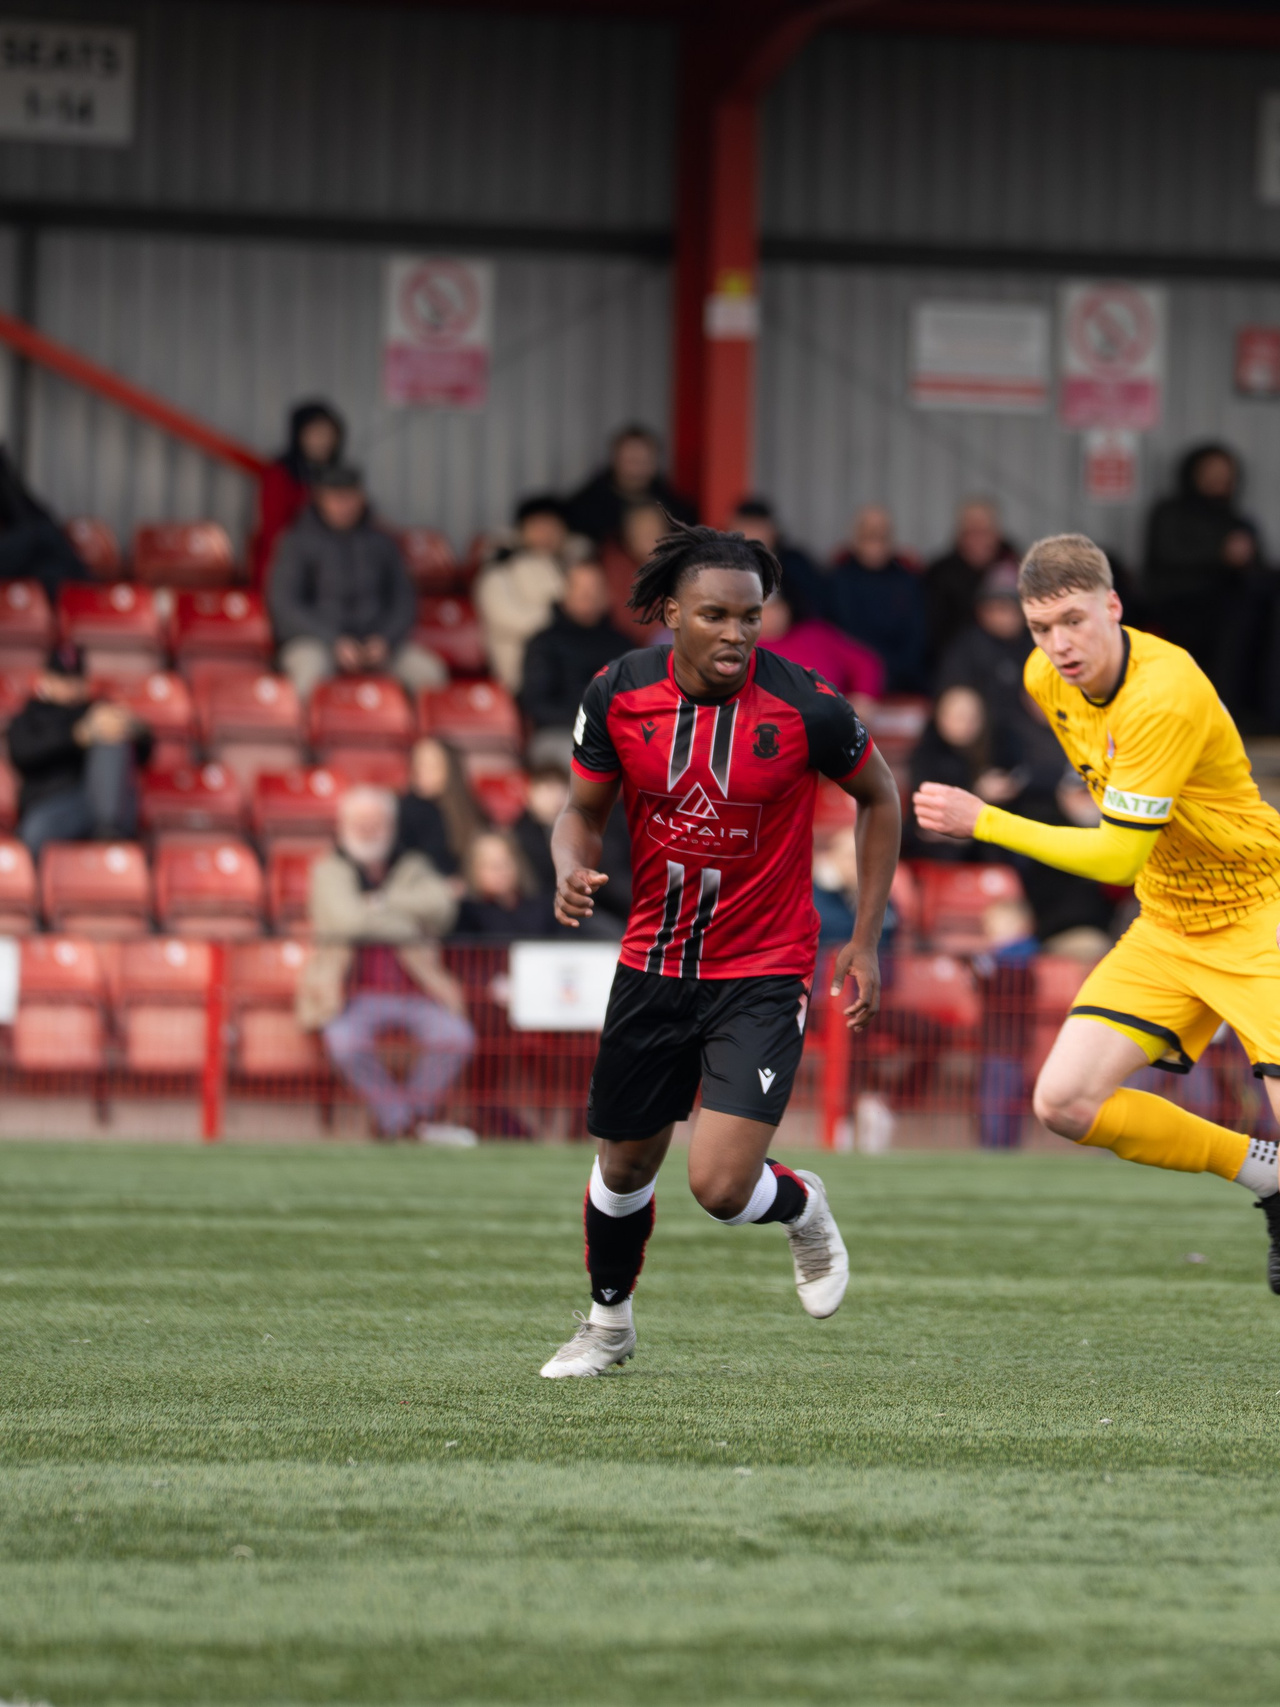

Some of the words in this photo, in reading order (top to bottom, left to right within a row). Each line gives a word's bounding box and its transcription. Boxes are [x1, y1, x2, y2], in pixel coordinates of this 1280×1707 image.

[2, 36, 120, 78] SEATS
[652, 813, 749, 839] ALTAIR
[670, 833, 721, 847] GROUP
